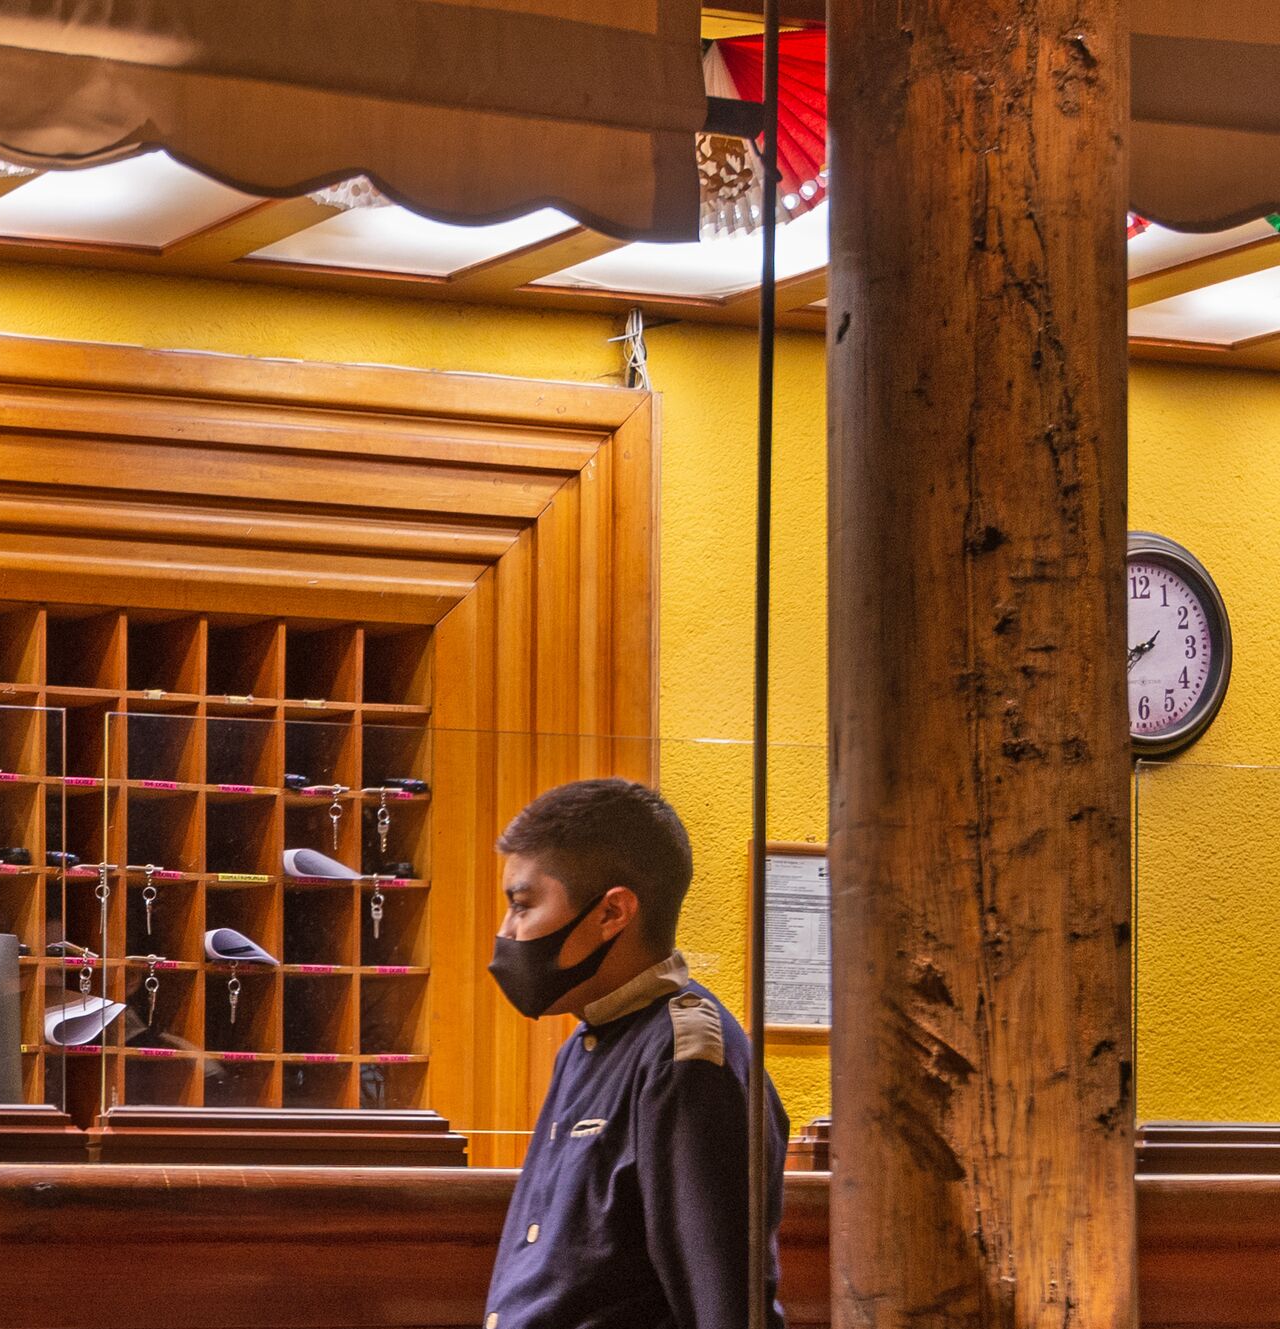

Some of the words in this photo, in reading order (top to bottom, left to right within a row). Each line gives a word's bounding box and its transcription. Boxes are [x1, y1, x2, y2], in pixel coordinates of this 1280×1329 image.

[1130, 575, 1151, 599] 12
[1160, 584, 1170, 607] 1
[1177, 606, 1189, 630] 2
[1185, 635, 1196, 659] 3
[1178, 665, 1190, 689] 4
[1138, 696, 1150, 720] 6
[1164, 688, 1175, 712] 5
